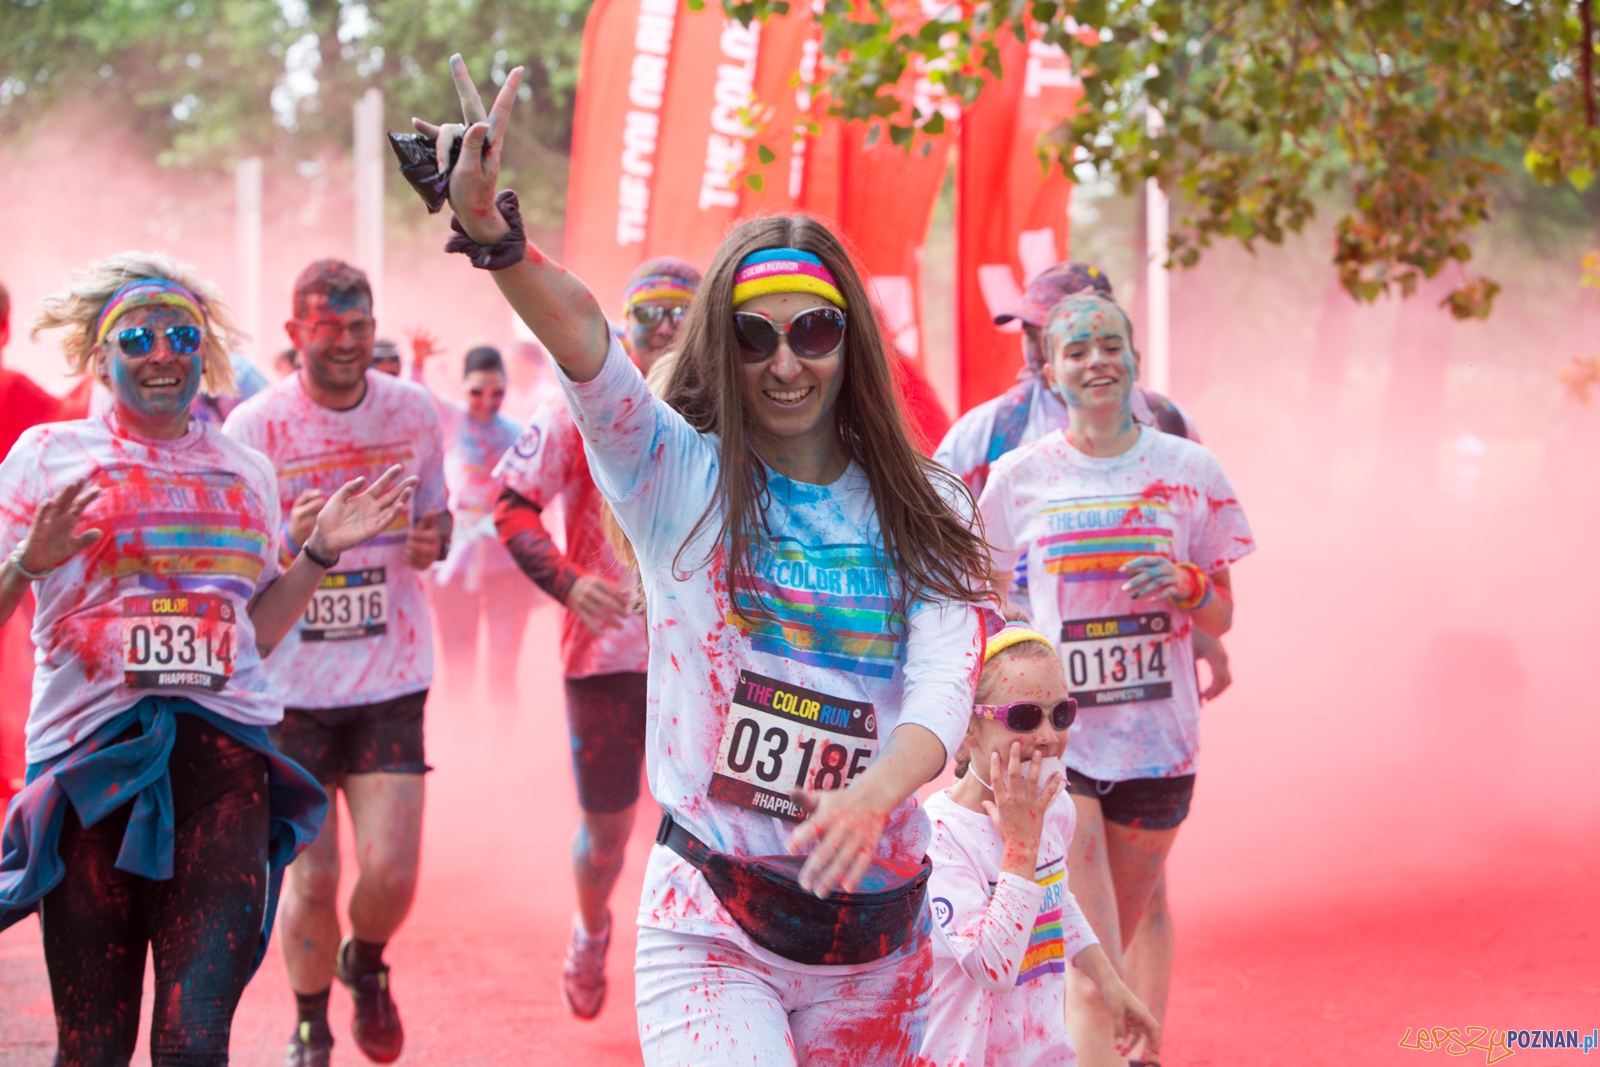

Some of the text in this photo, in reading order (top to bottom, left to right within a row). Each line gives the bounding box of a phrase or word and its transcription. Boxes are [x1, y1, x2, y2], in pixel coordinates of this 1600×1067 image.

[698, 133, 747, 211] THE
[742, 262, 799, 279] COLOR RUNNER
[1048, 512, 1074, 532] THE
[777, 560, 843, 595] COLOR
[845, 568, 891, 597] RUN
[152, 597, 189, 613] COLOR
[304, 591, 382, 625] 03316
[130, 624, 231, 667] 03314
[1067, 623, 1086, 639] THE
[1086, 620, 1119, 638] COLOR
[1069, 641, 1166, 686] 01314
[746, 681, 774, 707] THE
[772, 690, 821, 722] COLOR
